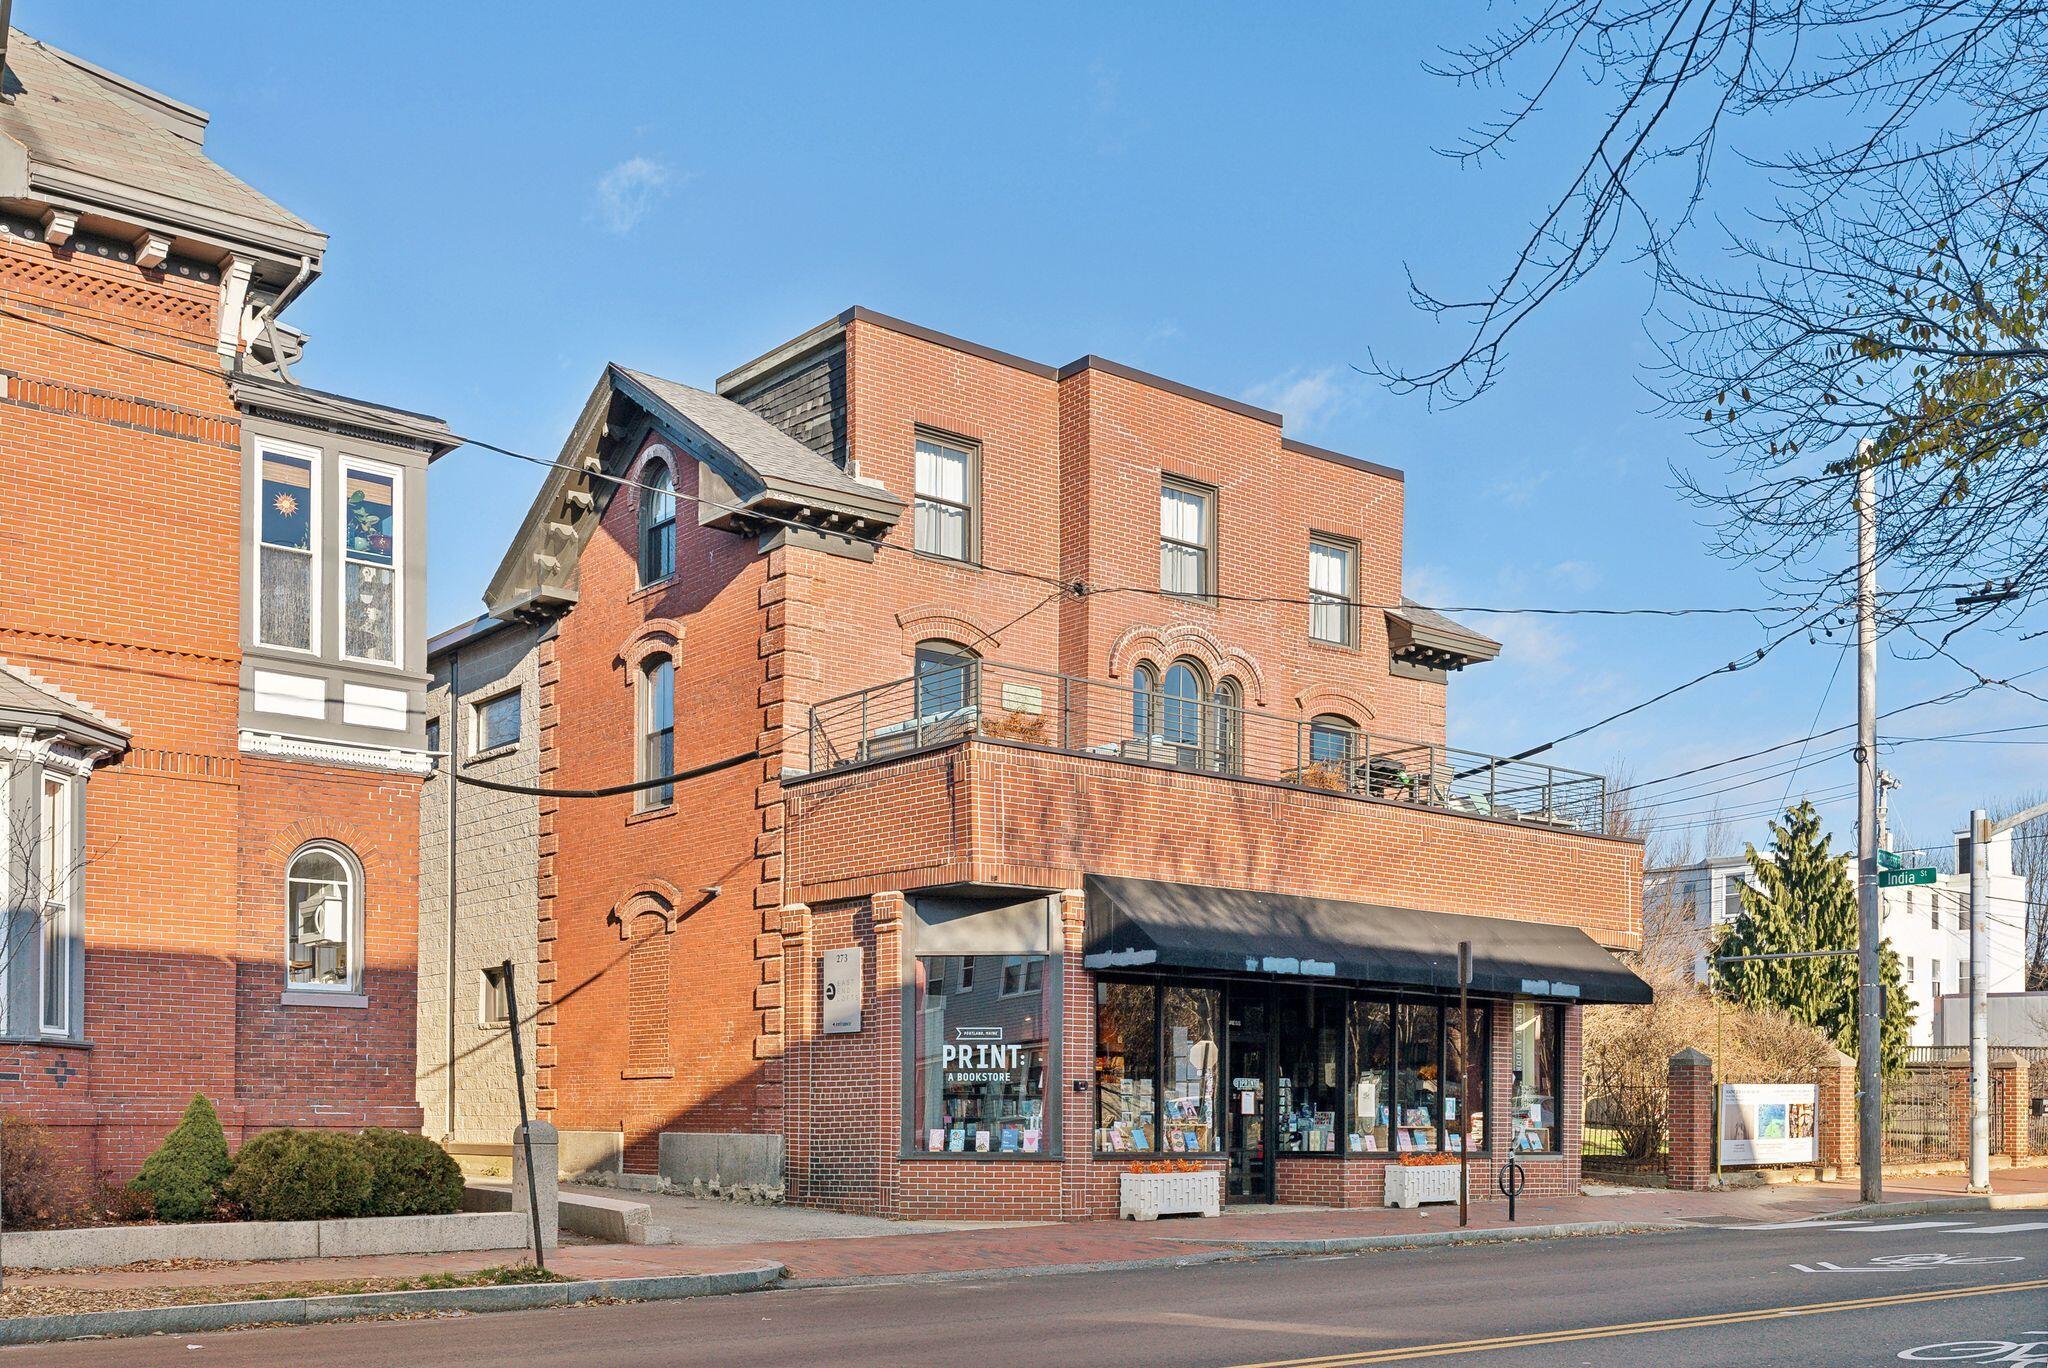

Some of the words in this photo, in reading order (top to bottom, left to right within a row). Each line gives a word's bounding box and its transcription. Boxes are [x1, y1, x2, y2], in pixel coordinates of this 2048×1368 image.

[1888, 871, 1915, 885] India
[836, 954, 848, 963] 273
[836, 979, 855, 987] EAST
[836, 987, 850, 995] END
[942, 1044, 1026, 1069] PRINT:
[948, 1072, 954, 1082] A
[957, 1072, 1011, 1082] BOOKSTORE
